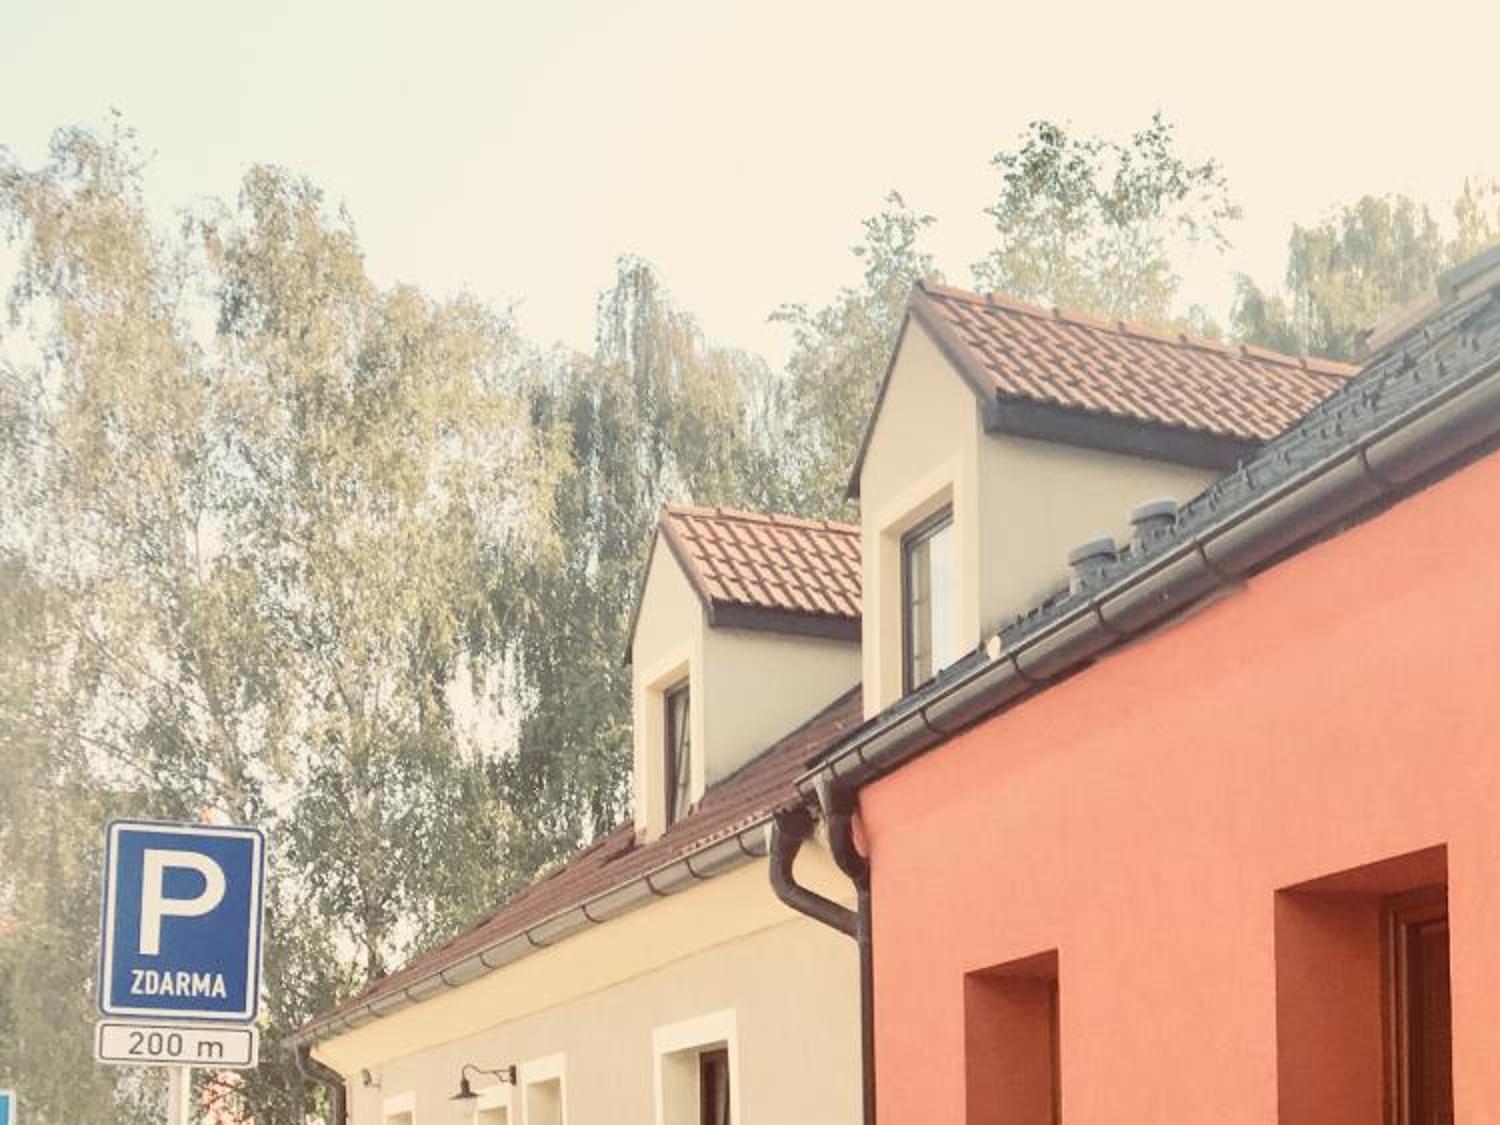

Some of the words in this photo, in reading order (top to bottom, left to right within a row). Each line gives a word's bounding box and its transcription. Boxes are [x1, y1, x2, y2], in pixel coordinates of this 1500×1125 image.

[139, 849, 226, 955] P
[130, 970, 227, 998] ZDARMA
[128, 1032, 183, 1056] 200
[197, 1040, 223, 1058] m
